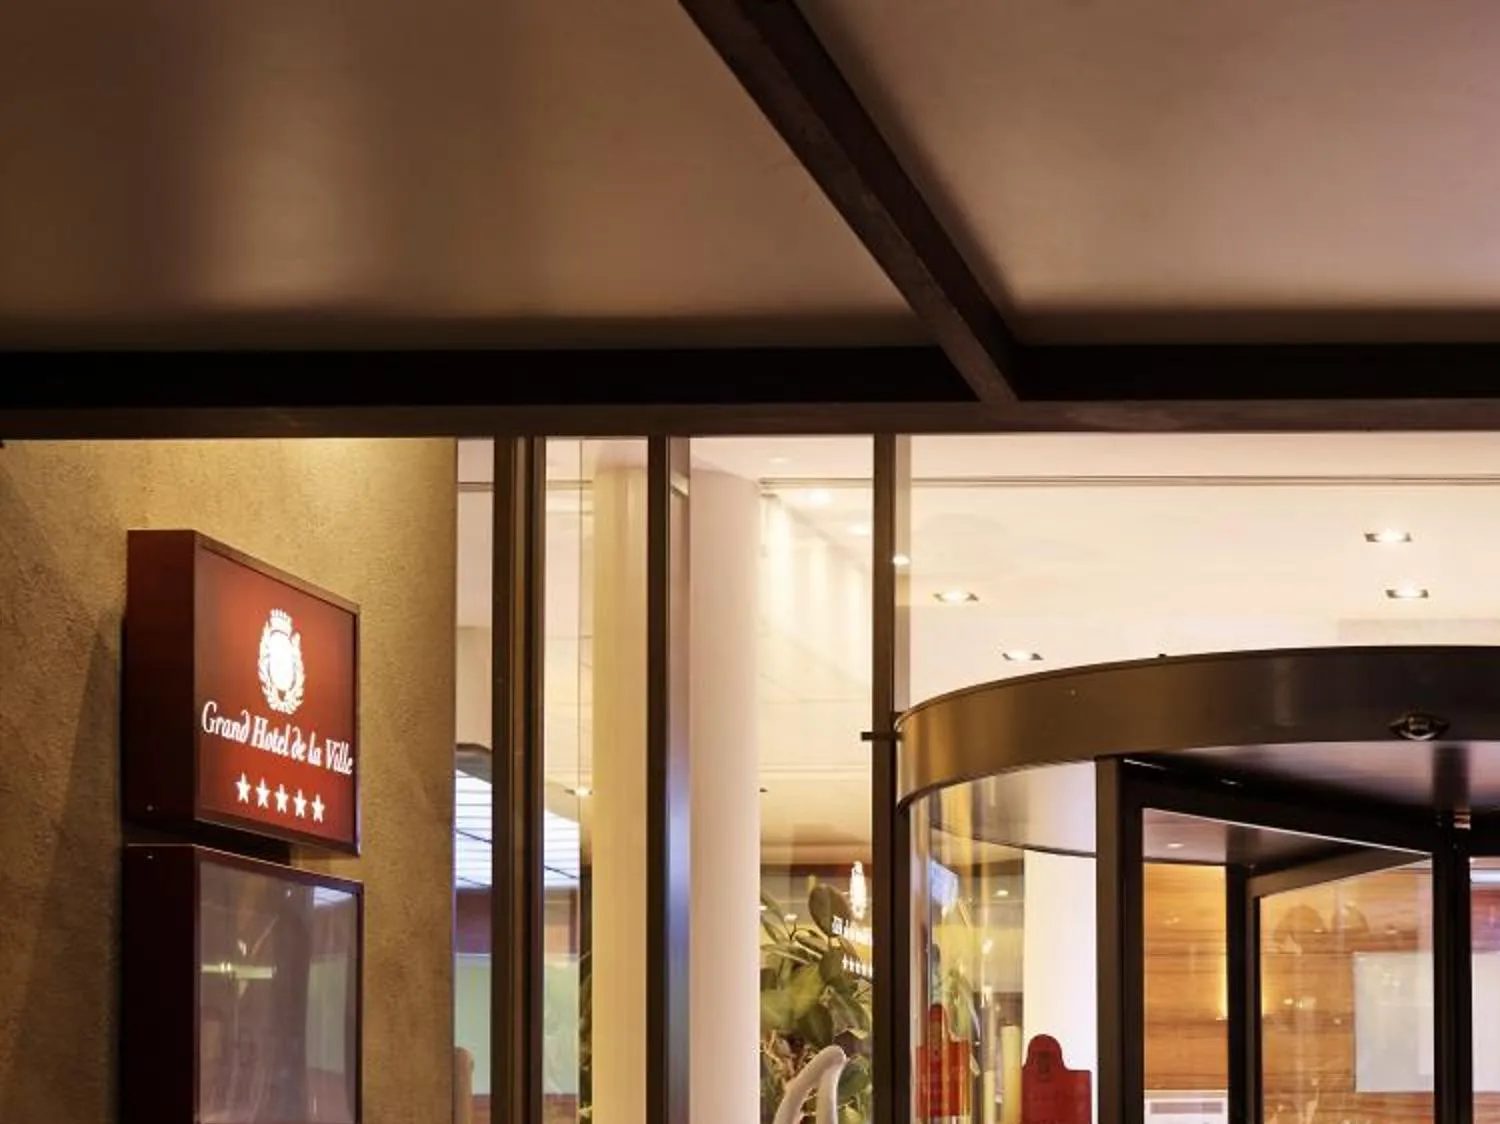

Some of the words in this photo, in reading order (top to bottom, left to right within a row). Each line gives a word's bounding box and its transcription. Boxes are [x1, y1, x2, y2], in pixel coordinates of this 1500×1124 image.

[202, 700, 251, 744] Grand
[250, 715, 291, 757] Hotel
[291, 726, 307, 761] de
[308, 731, 322, 766] la
[325, 739, 353, 775] Ville
